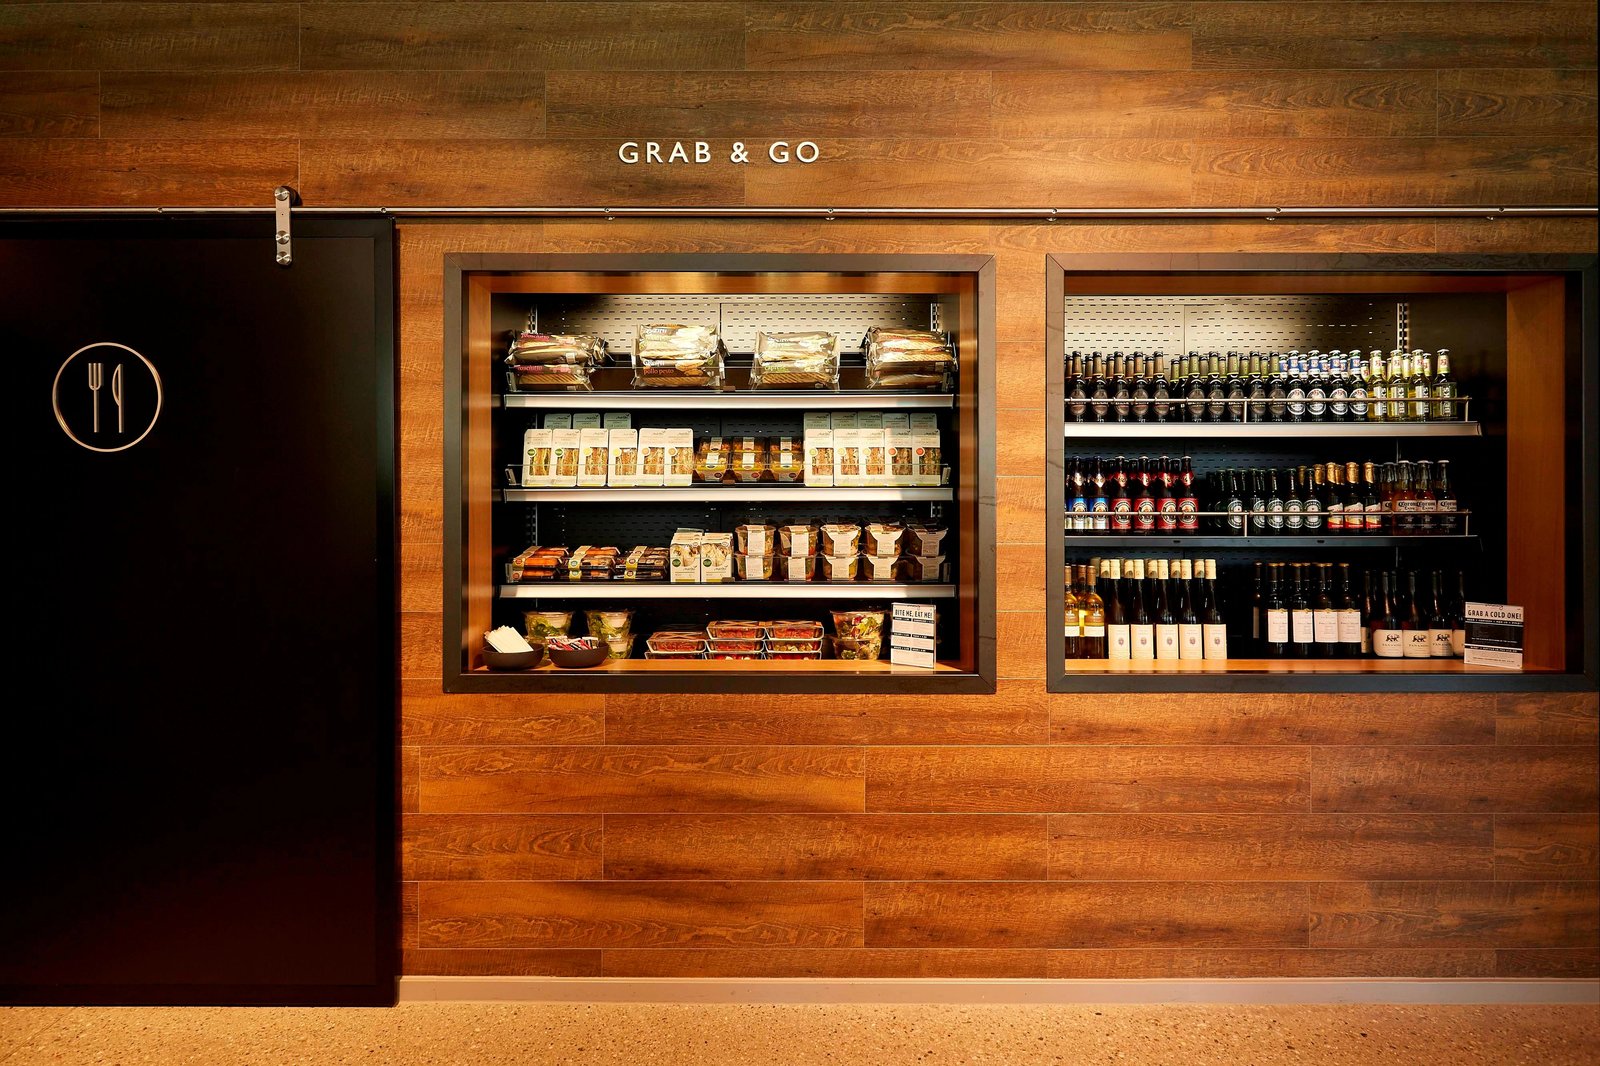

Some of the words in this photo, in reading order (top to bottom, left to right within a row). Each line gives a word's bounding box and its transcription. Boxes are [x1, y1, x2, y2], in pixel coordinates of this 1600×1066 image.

[618, 141, 712, 164] GRAB
[730, 141, 749, 163] &
[768, 141, 820, 164] GO
[1467, 609, 1483, 617] GRAB
[1490, 611, 1506, 619] COLD
[1507, 612, 1522, 620] ONE!
